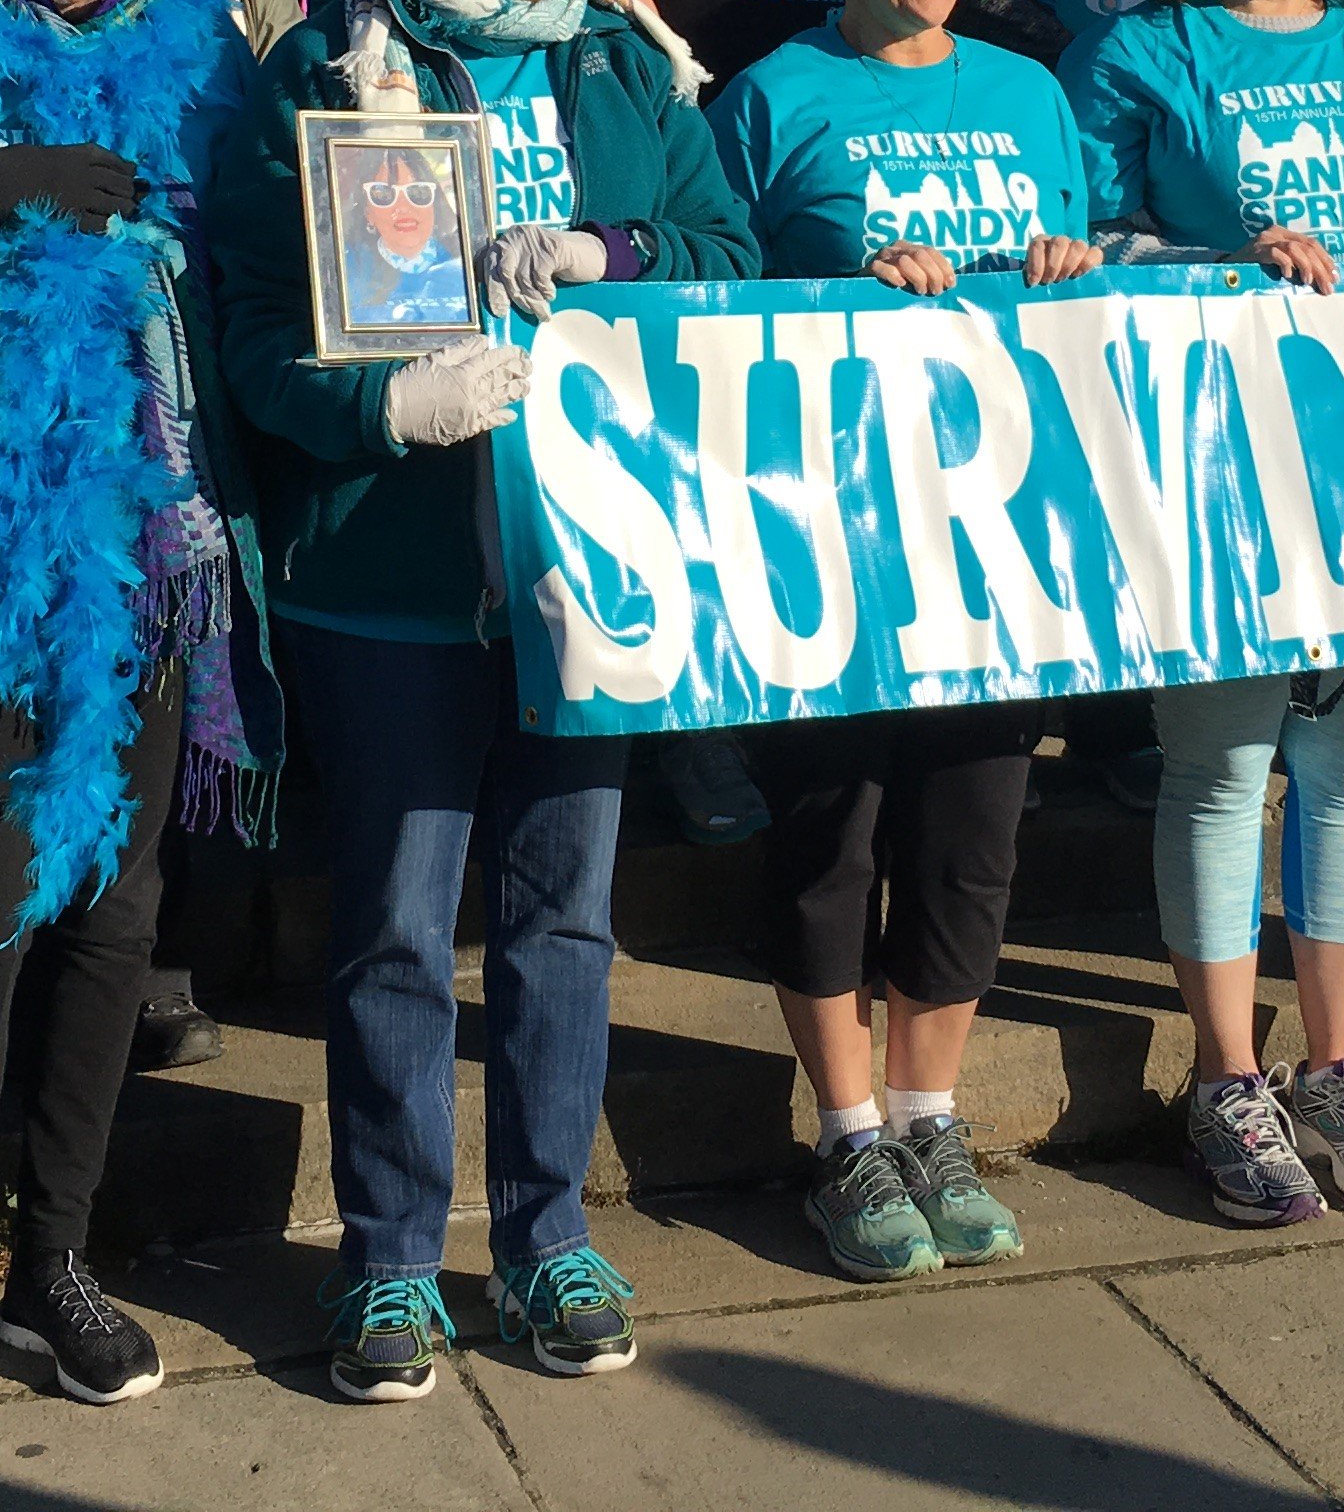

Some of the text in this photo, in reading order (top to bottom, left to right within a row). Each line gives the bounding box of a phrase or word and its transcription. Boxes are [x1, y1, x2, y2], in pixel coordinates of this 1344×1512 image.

[1254, 111, 1288, 123] 15TH
[845, 130, 1021, 162] SURVIVOR
[882, 160, 972, 172] 15TH ANNUAL
[496, 180, 572, 225] RIN
[866, 207, 1034, 250] SANDY
